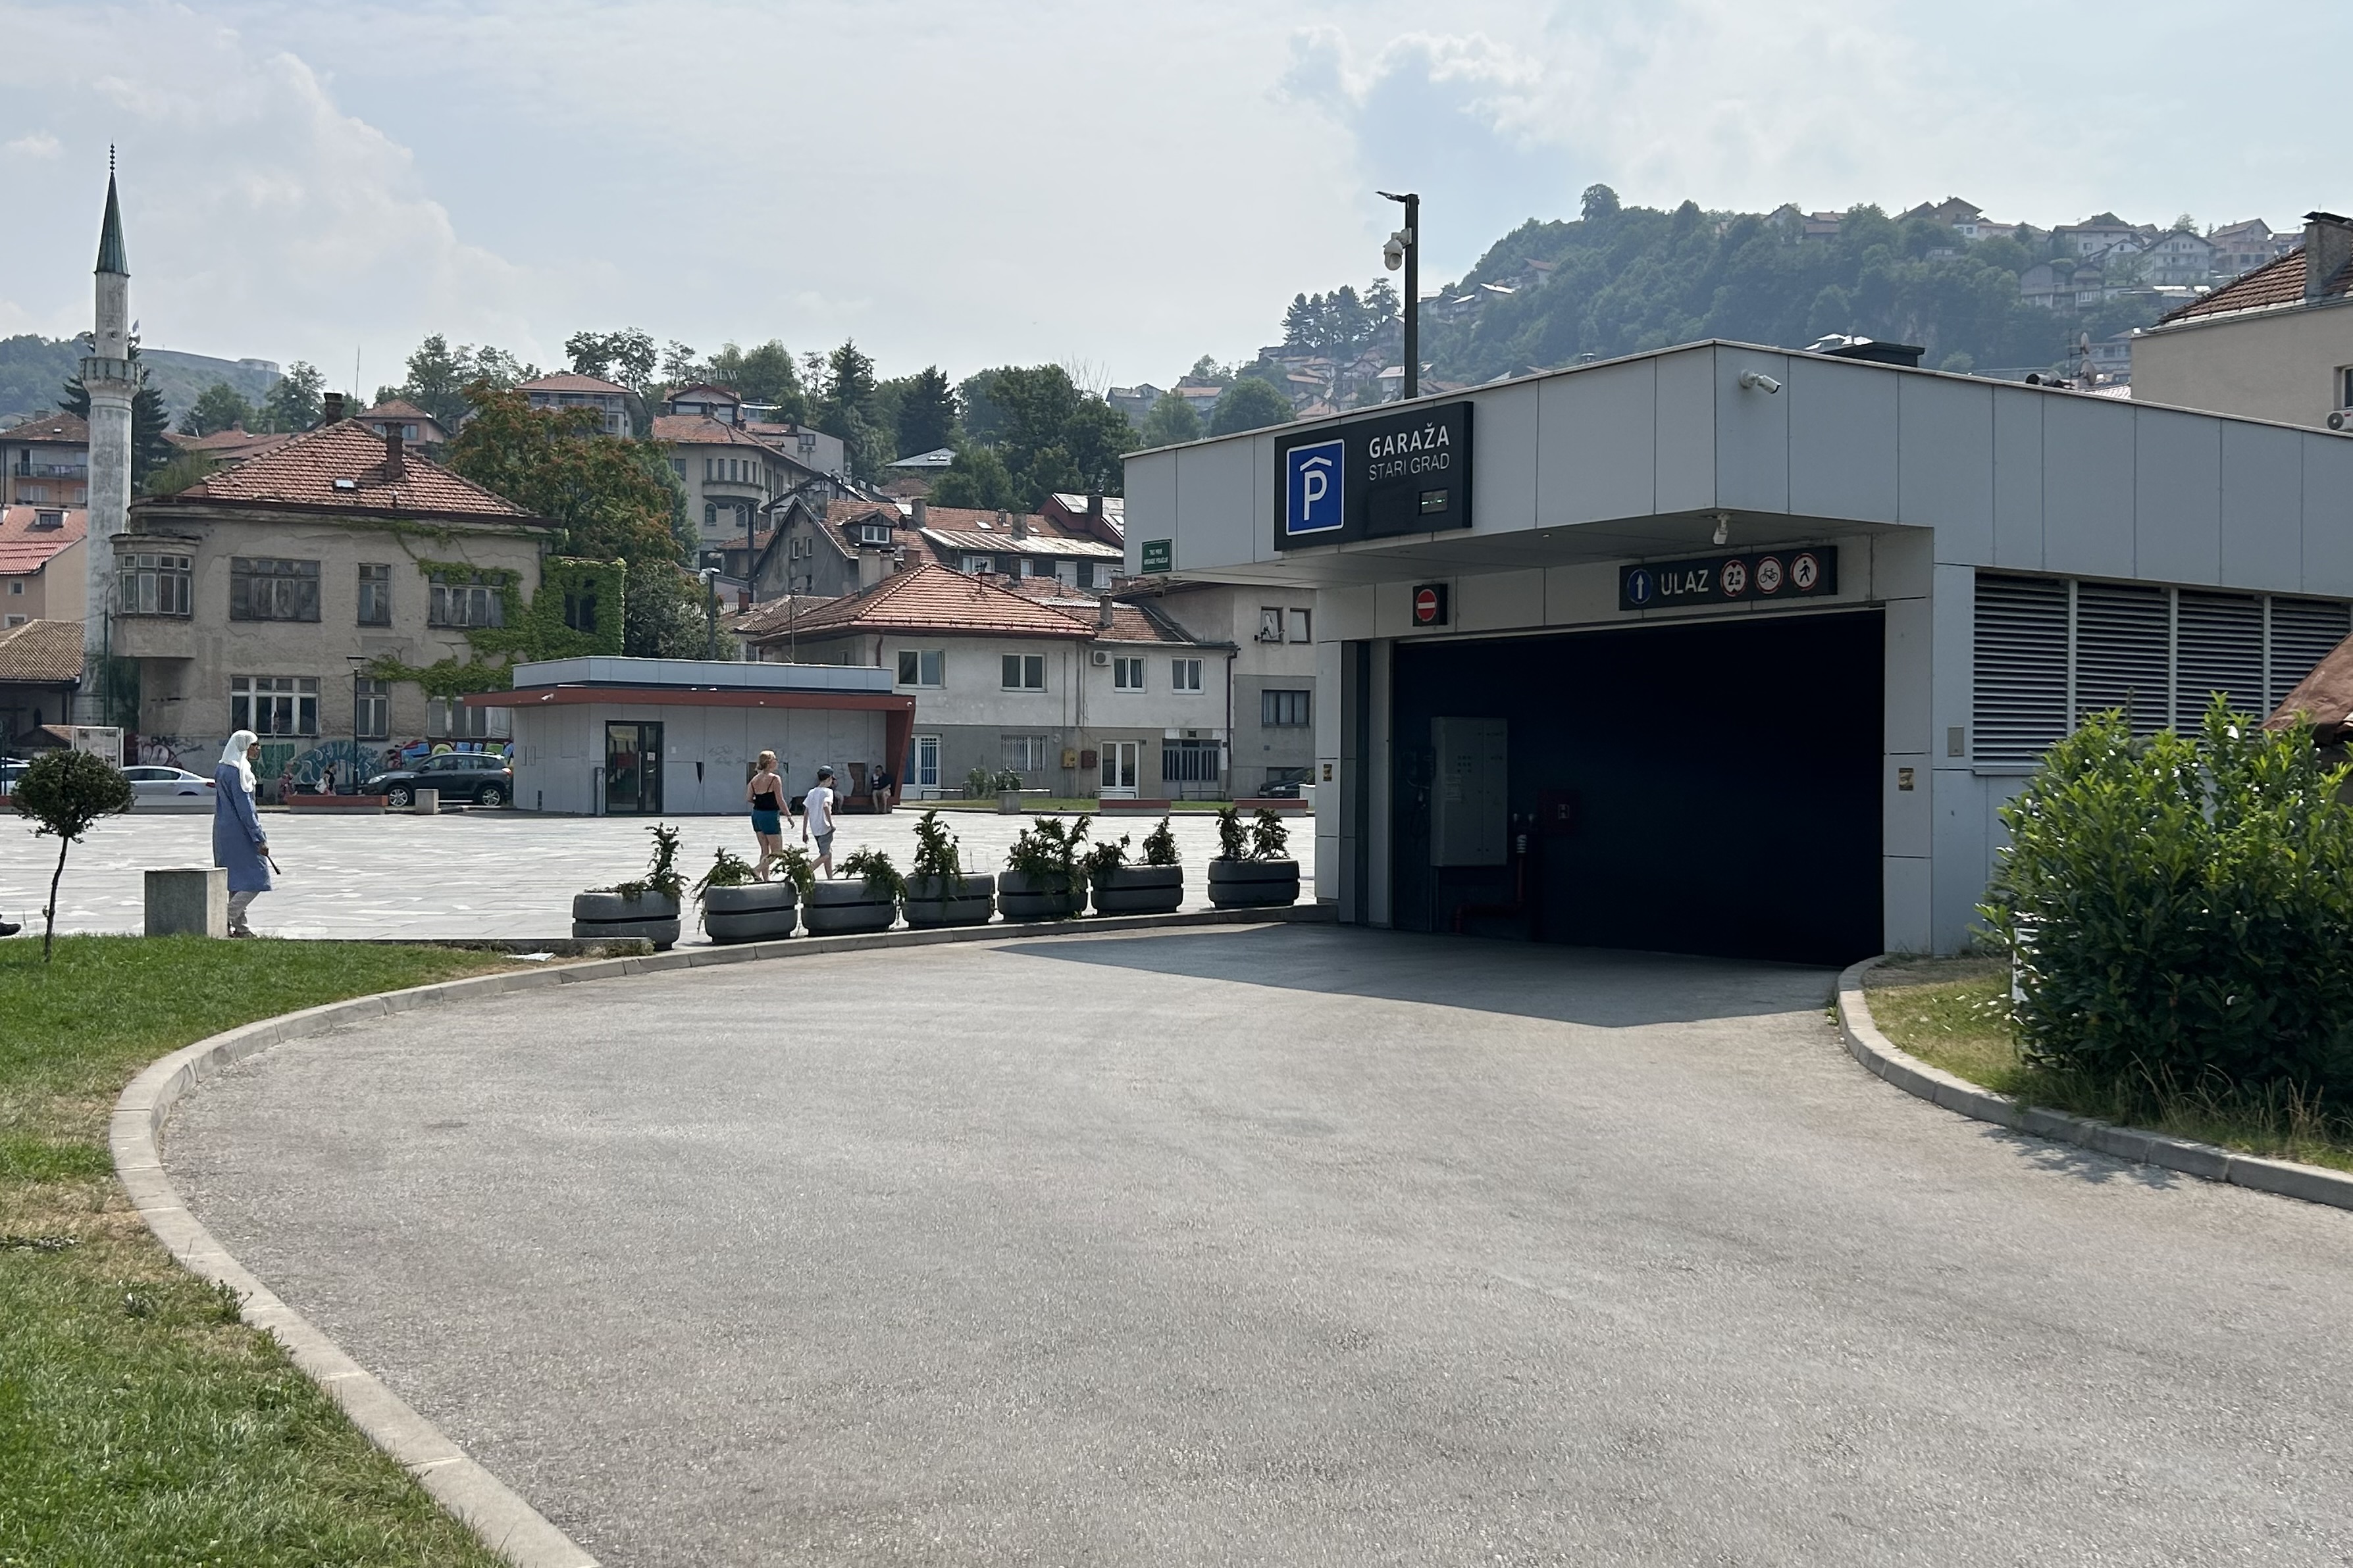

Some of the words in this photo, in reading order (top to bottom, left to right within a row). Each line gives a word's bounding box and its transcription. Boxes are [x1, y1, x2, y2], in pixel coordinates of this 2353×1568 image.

[1369, 422, 1450, 459] GARAŽA
[1369, 459, 1407, 481] STARI
[1410, 453, 1450, 474] GRAD
[1304, 470, 1328, 521] P
[1661, 569, 1709, 595] ULAZ
